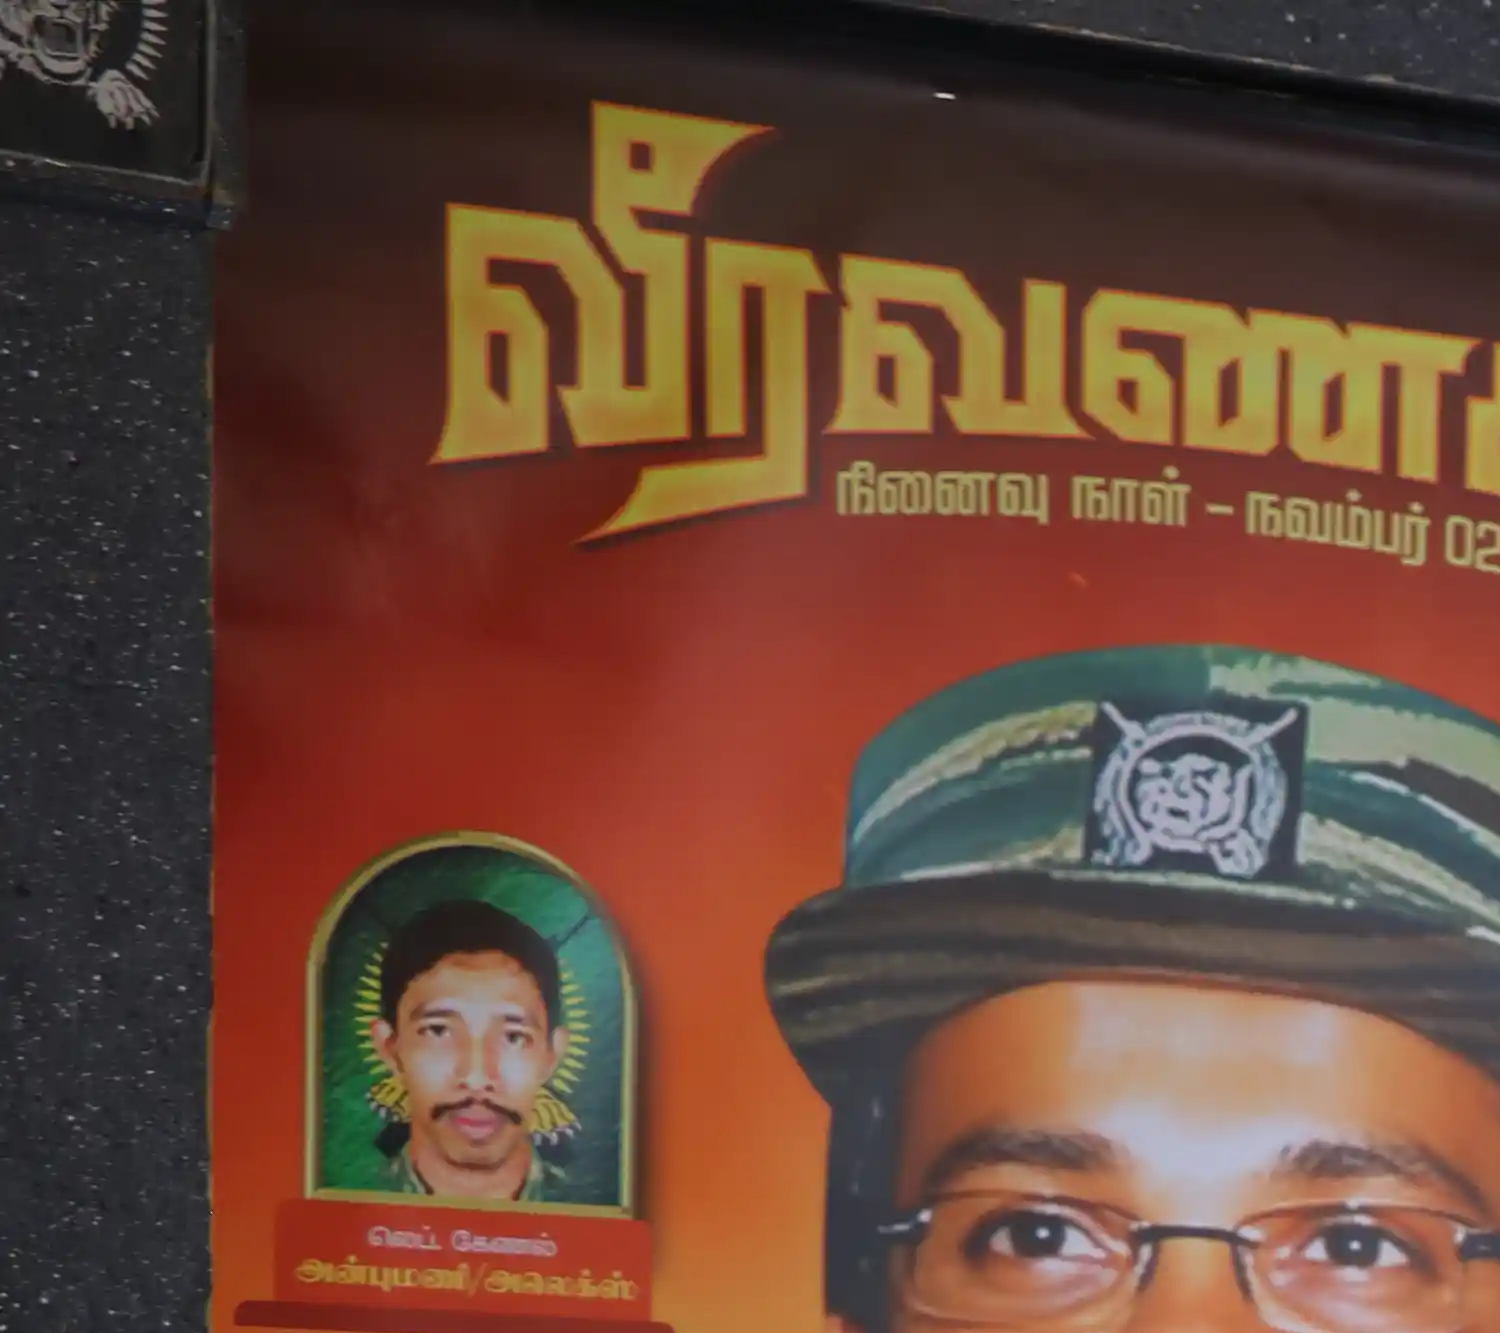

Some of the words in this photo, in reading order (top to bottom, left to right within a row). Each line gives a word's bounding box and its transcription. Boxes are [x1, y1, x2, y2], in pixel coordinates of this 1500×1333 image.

[835, 460, 1049, 526] நினைவு
[1071, 466, 1192, 527] நாள்
[1246, 487, 1431, 567] நவம்பர்
